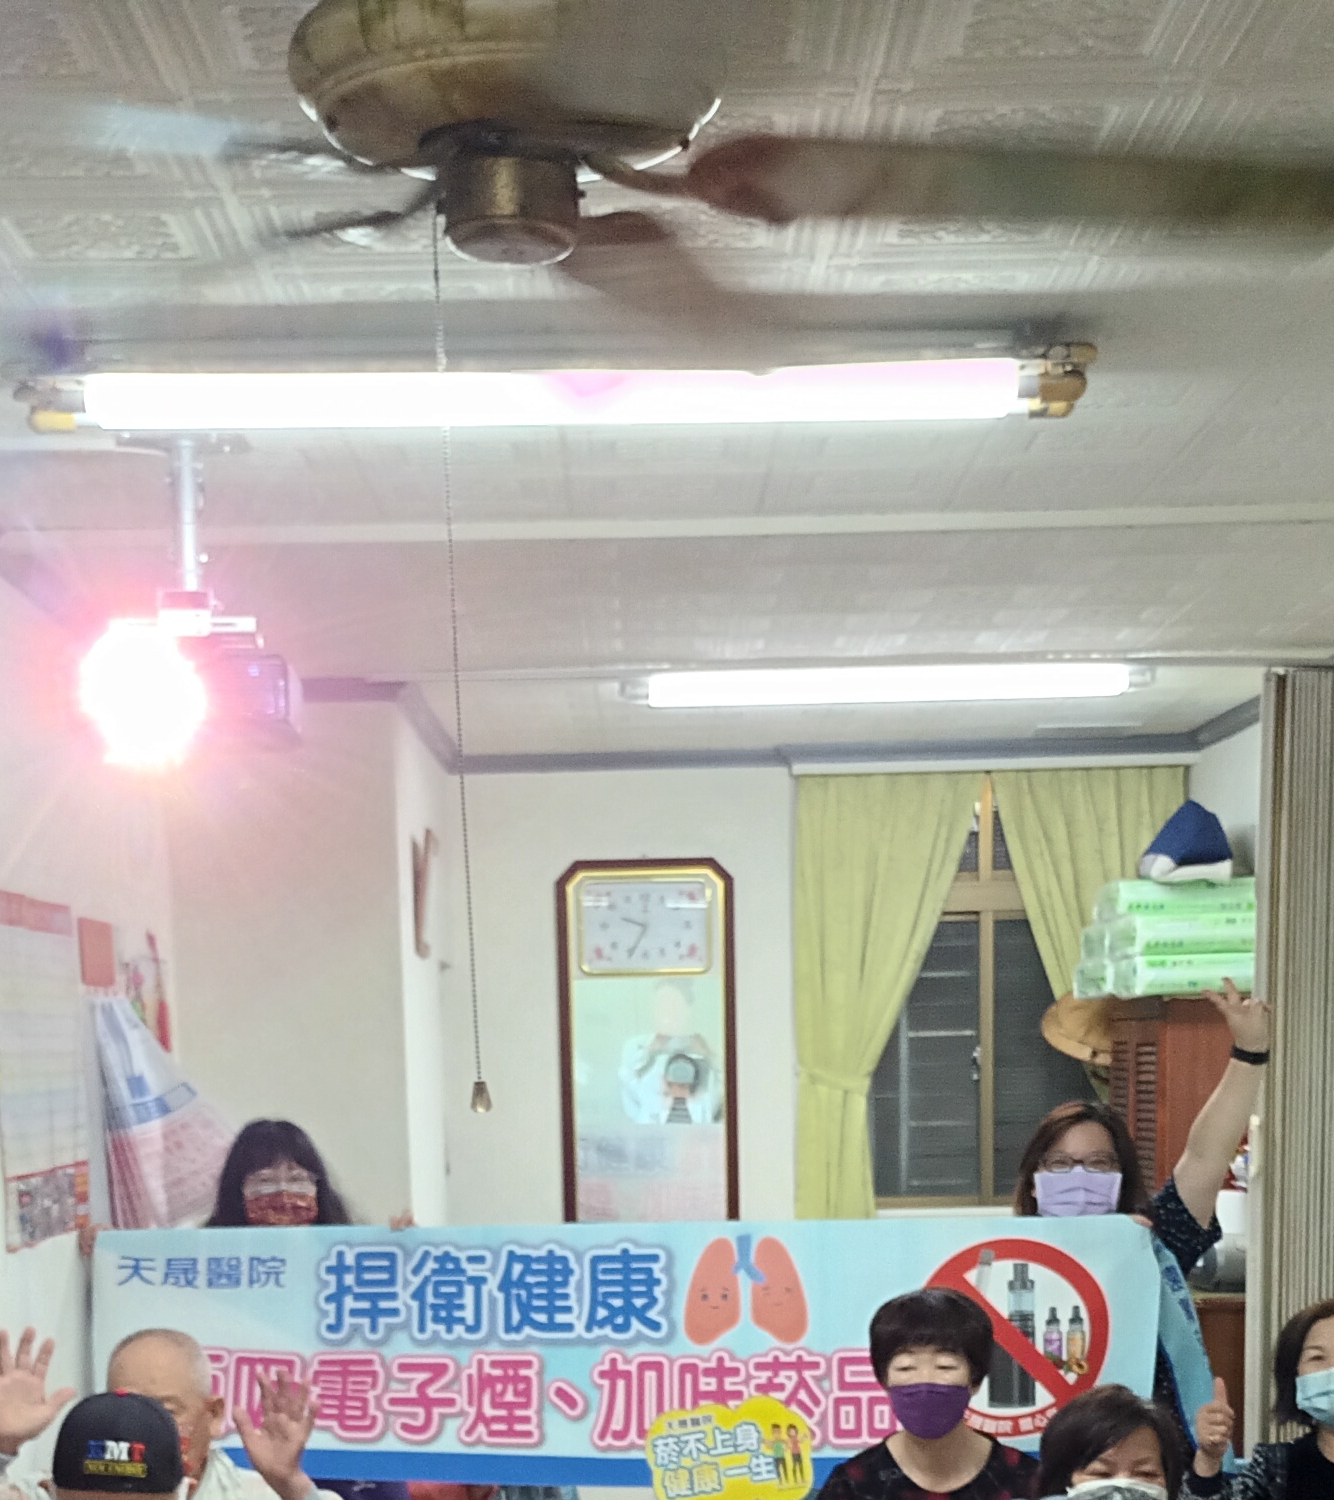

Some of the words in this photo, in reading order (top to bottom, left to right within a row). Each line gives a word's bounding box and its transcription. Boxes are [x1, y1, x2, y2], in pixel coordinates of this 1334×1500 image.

[118, 1256, 287, 1289] 天晟醫院
[322, 1247, 666, 1339] 捍衛健康
[652, 1421, 761, 1469] 菸不上身
[662, 1454, 779, 1500] 健康一生
